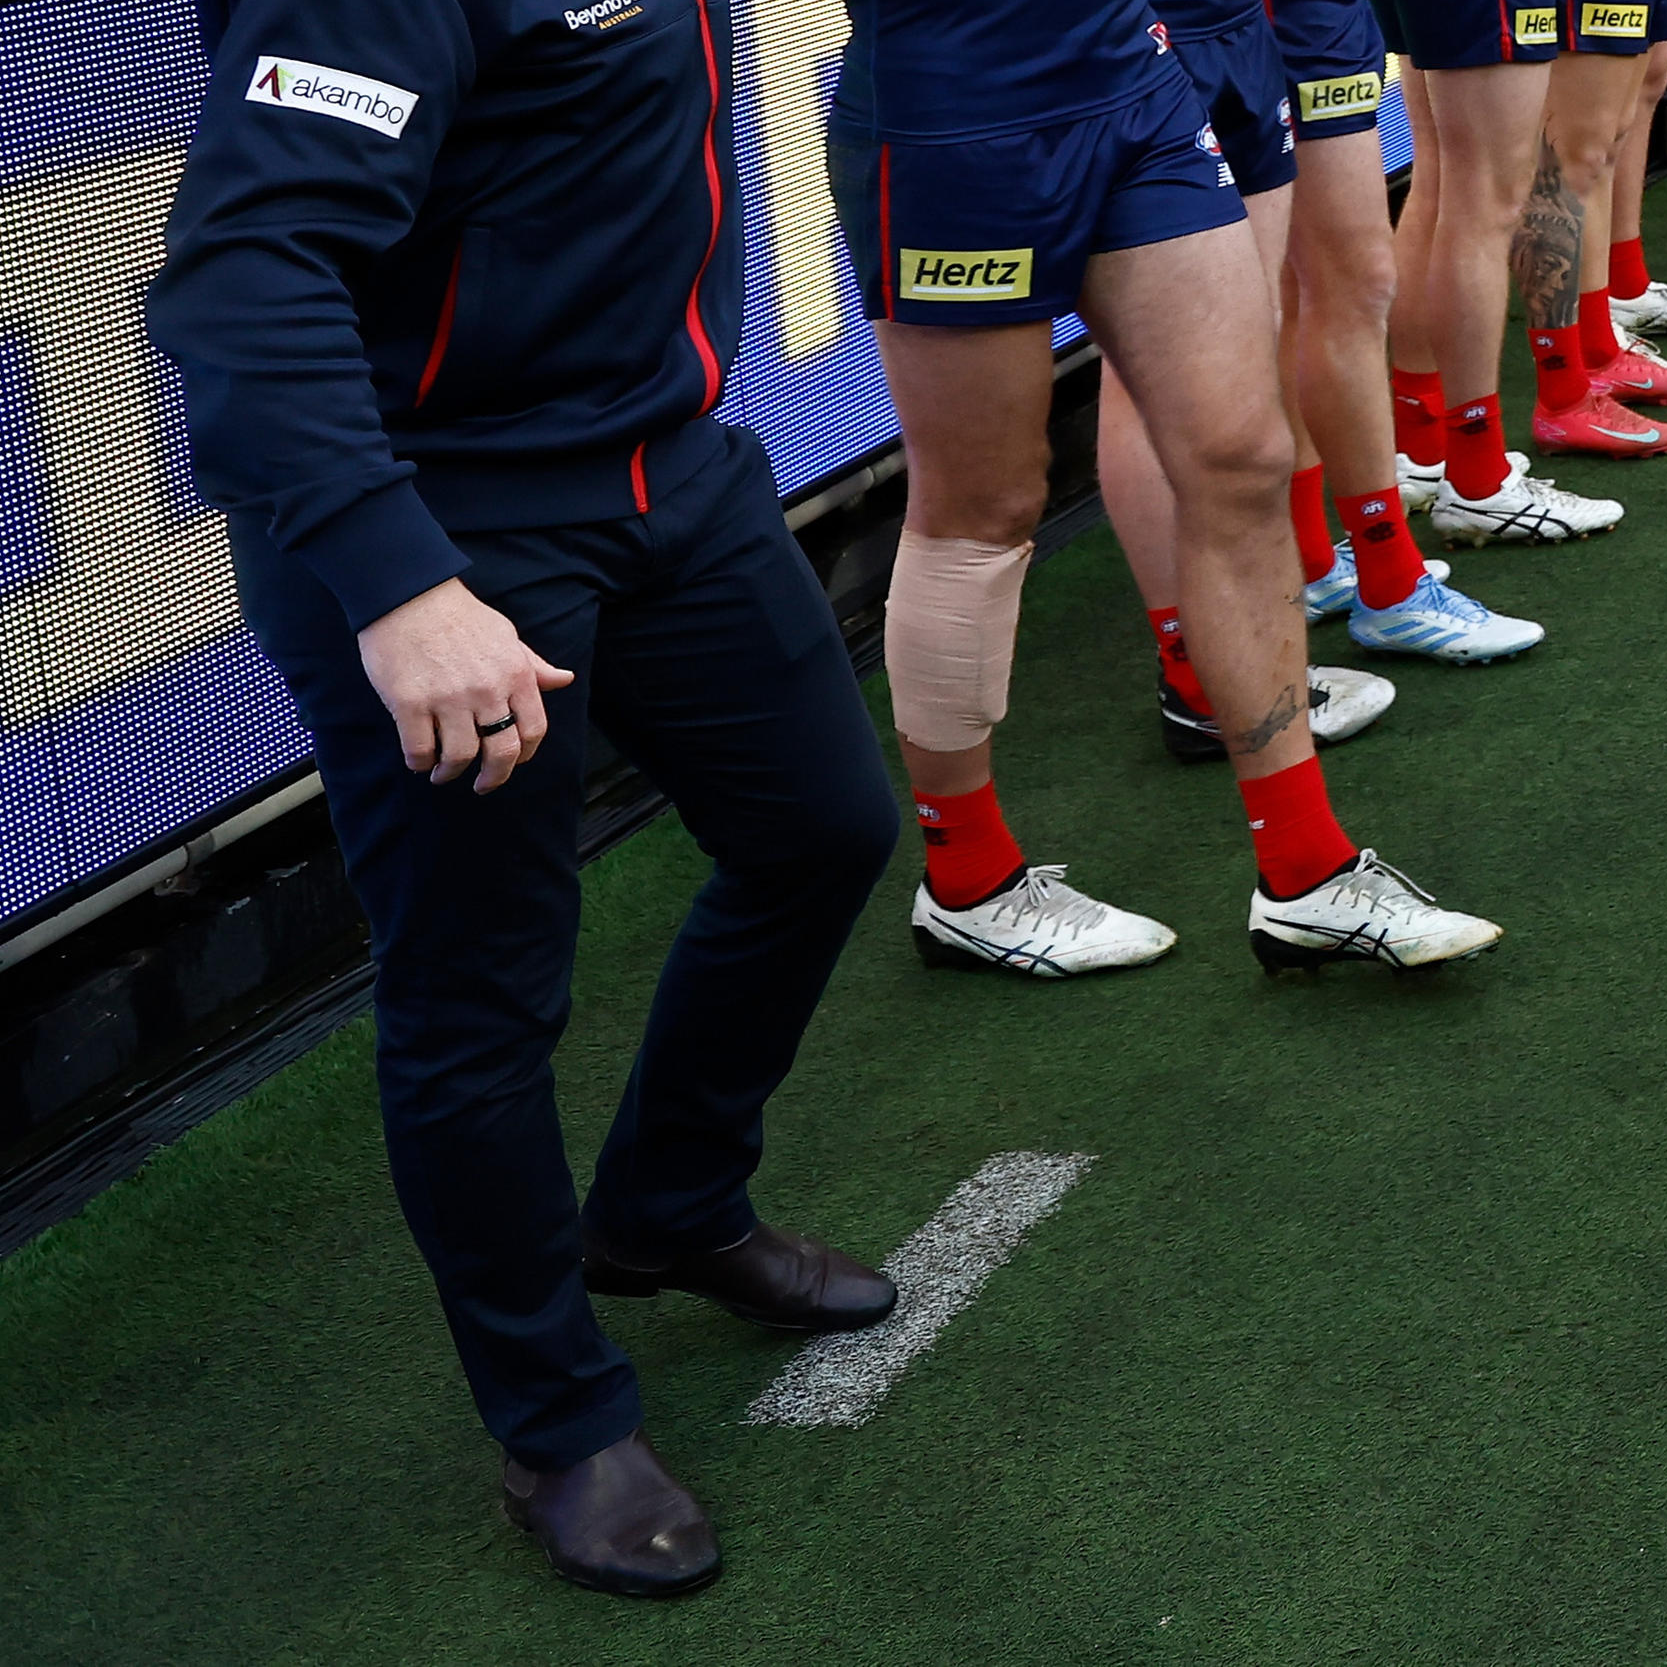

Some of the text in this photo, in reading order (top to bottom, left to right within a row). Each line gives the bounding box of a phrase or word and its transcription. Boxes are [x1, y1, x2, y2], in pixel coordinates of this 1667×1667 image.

[598, 5, 643, 31] AUSTRALIA
[1591, 8, 1644, 28] Hertz
[291, 74, 405, 125] akambo
[1311, 79, 1377, 109] Hertz
[914, 256, 1023, 288] Hertz
